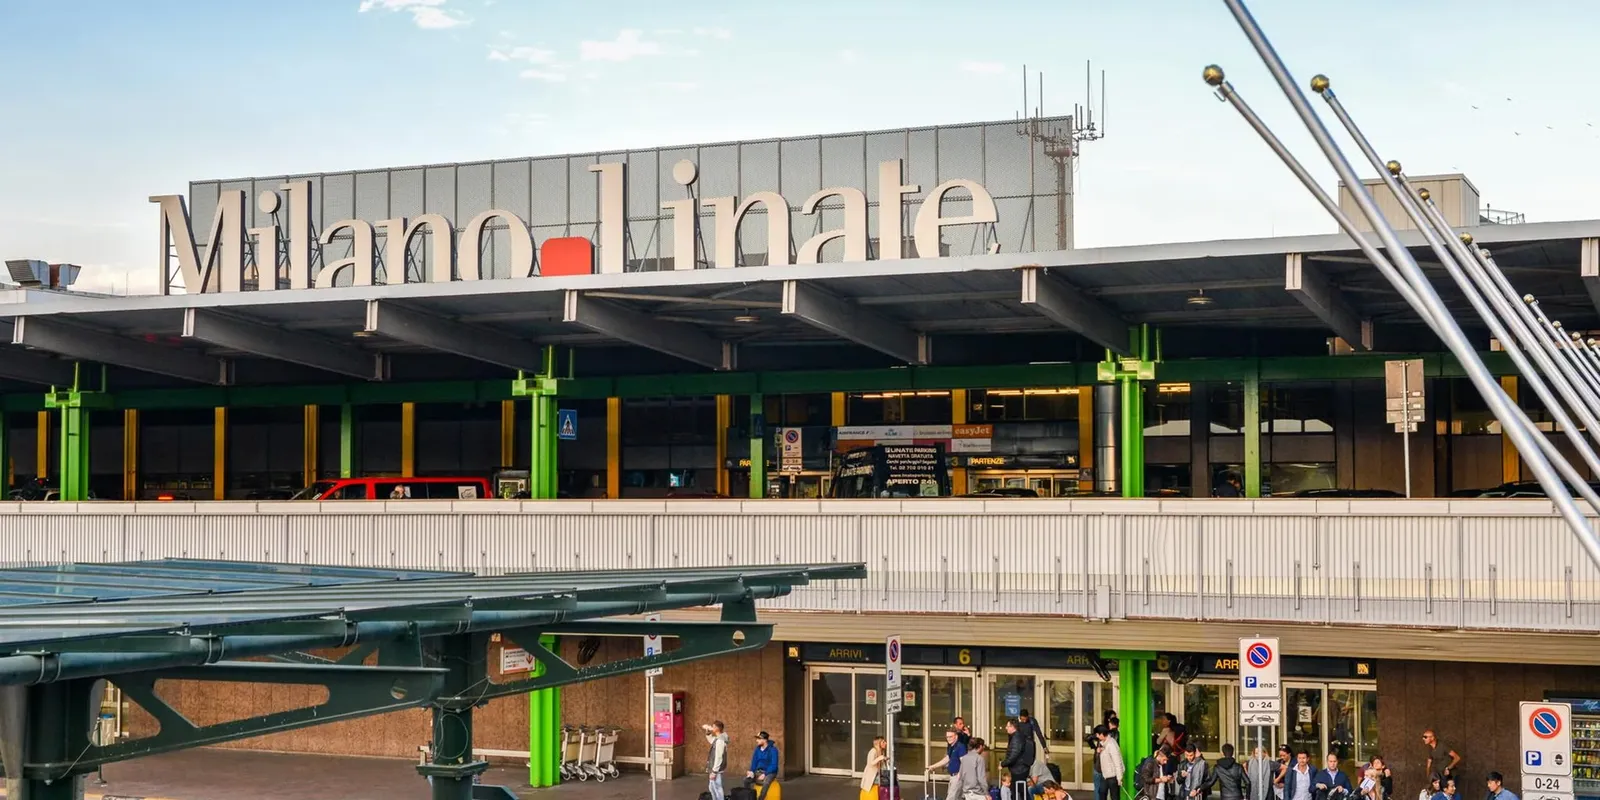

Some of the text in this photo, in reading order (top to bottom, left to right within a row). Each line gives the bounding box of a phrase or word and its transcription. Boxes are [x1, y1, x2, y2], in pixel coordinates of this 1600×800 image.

[149, 181, 534, 295] Milano
[955, 426, 990, 436] easyJet
[952, 456, 959, 466] 3
[971, 456, 1004, 465] PARTENZE
[829, 649, 862, 658] ARRIVI
[959, 649, 970, 665] 6
[1535, 777, 1560, 790] 0-24
